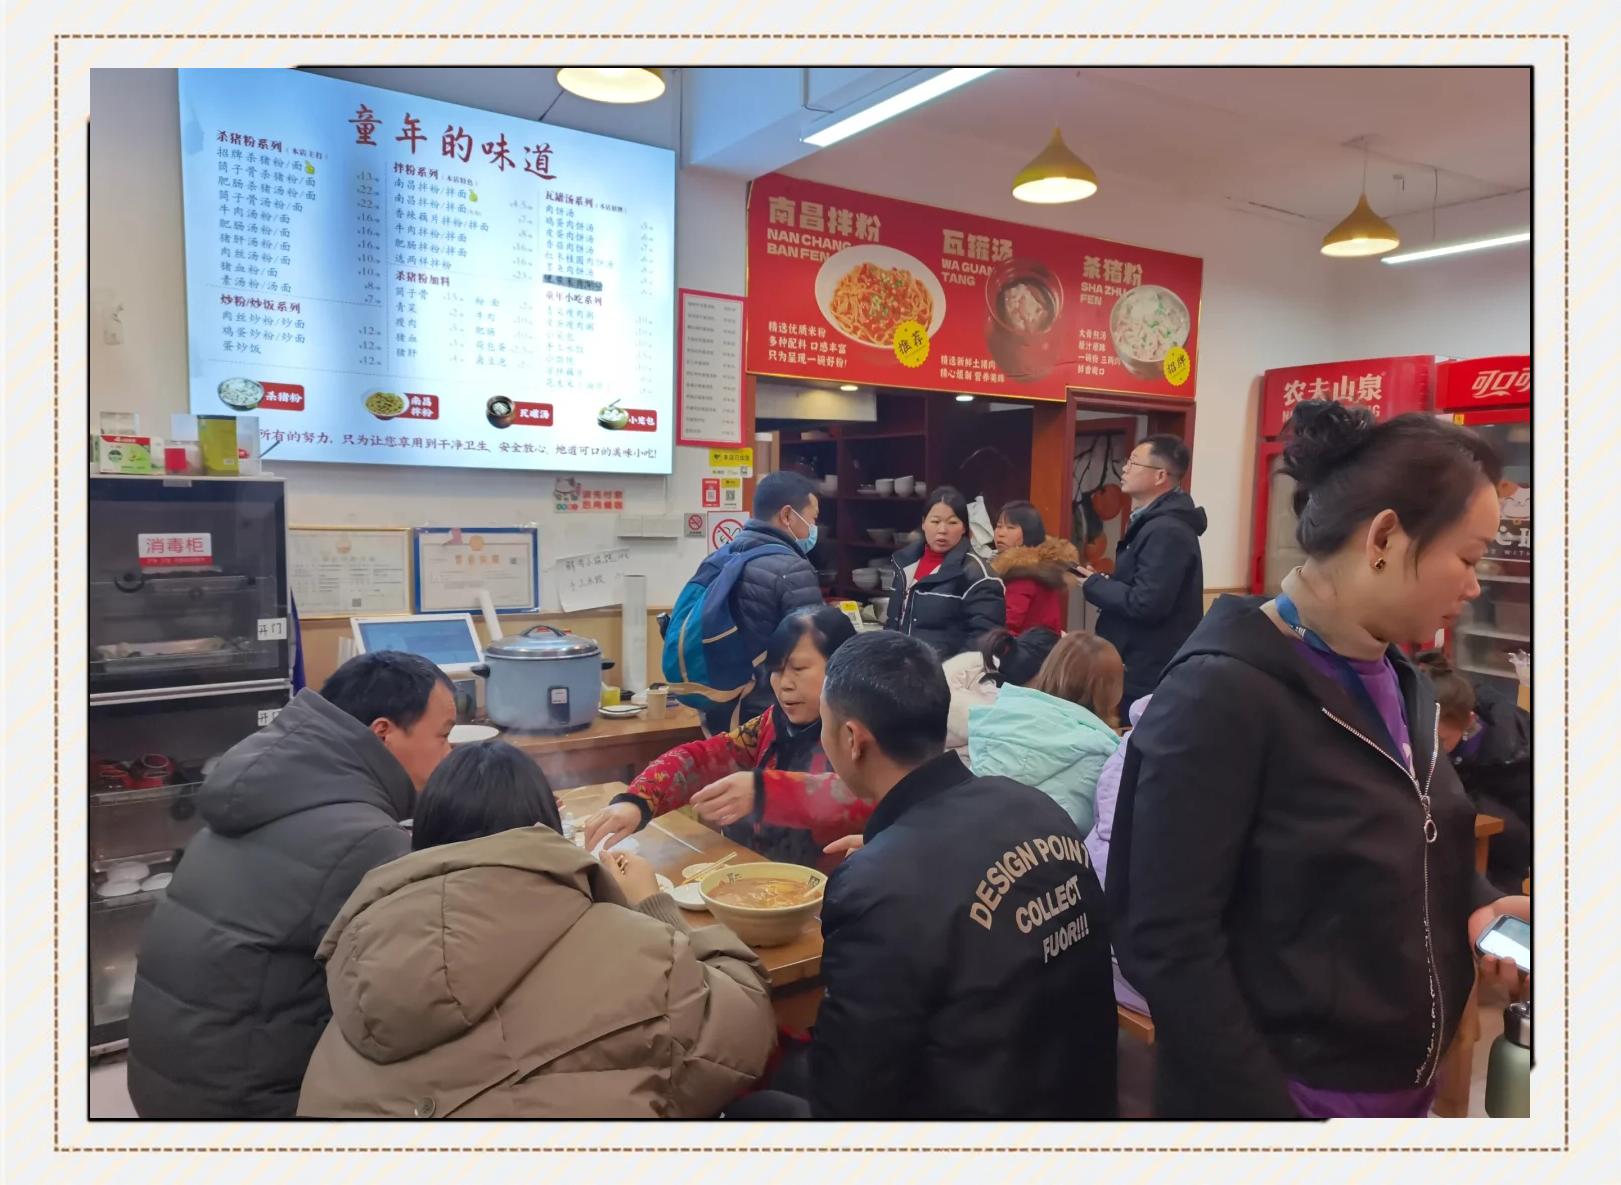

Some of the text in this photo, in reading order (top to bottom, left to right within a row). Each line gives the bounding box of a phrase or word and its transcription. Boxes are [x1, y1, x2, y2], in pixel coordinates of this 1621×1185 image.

[216, 131, 282, 153] 杀猪粉系列
[348, 103, 557, 180] 童年的味道
[217, 147, 302, 171] 招牌杀猪粉/面
[218, 162, 316, 187] 筒子骨杀猪粉/面
[394, 161, 439, 180] 拌粉系列
[394, 178, 466, 200] 南昌拌粉/拌面
[218, 190, 303, 213] 筒子骨汤粉/面
[394, 193, 466, 214] 南昌拌粉/拌面
[546, 190, 593, 209] 瓦罐汤系列
[219, 204, 290, 224] 牛肉汤粉/面
[768, 196, 881, 243] 南昌拌粉
[220, 219, 291, 238] 肥肠汤粉/面
[395, 223, 467, 243] 牛肉拌粉/拌面
[767, 228, 800, 245] NAN
[220, 234, 291, 252] 猪肝汤粉/面
[395, 239, 467, 258] 肥肠拌粉/拌面
[943, 229, 1013, 263] 瓦罐汤
[220, 247, 291, 266] 肉丝汤粉/面
[767, 242, 831, 264] BAN FEN
[221, 261, 278, 278] 猪血粉/面
[942, 258, 960, 272] WA
[395, 270, 450, 288] 杀猪粉加料
[941, 271, 976, 287] TANG
[1080, 282, 1104, 294] SHA
[220, 293, 301, 314] 炒粉/炒饭系列
[1080, 293, 1103, 306] FEN
[222, 311, 305, 330] 肉丝炒粉/炒面
[768, 320, 827, 338] 精选优质米粉
[223, 326, 305, 345] 鸡蛋炒粉/炒面
[769, 335, 847, 355] 多种配料 口感丰富
[898, 330, 923, 355] 推荐
[223, 340, 262, 355] 蛋炒饭
[1168, 355, 1186, 375] 招牌
[266, 391, 303, 404] 杀猪粉
[1283, 374, 1383, 406] 农夫山泉
[519, 408, 550, 420] 瓦罐汤
[146, 536, 204, 554] 消毒柜
[969, 835, 1089, 931] DESIGN POINT
[1015, 874, 1082, 934] COLLECT
[1042, 912, 1090, 964] FUOR!!!
